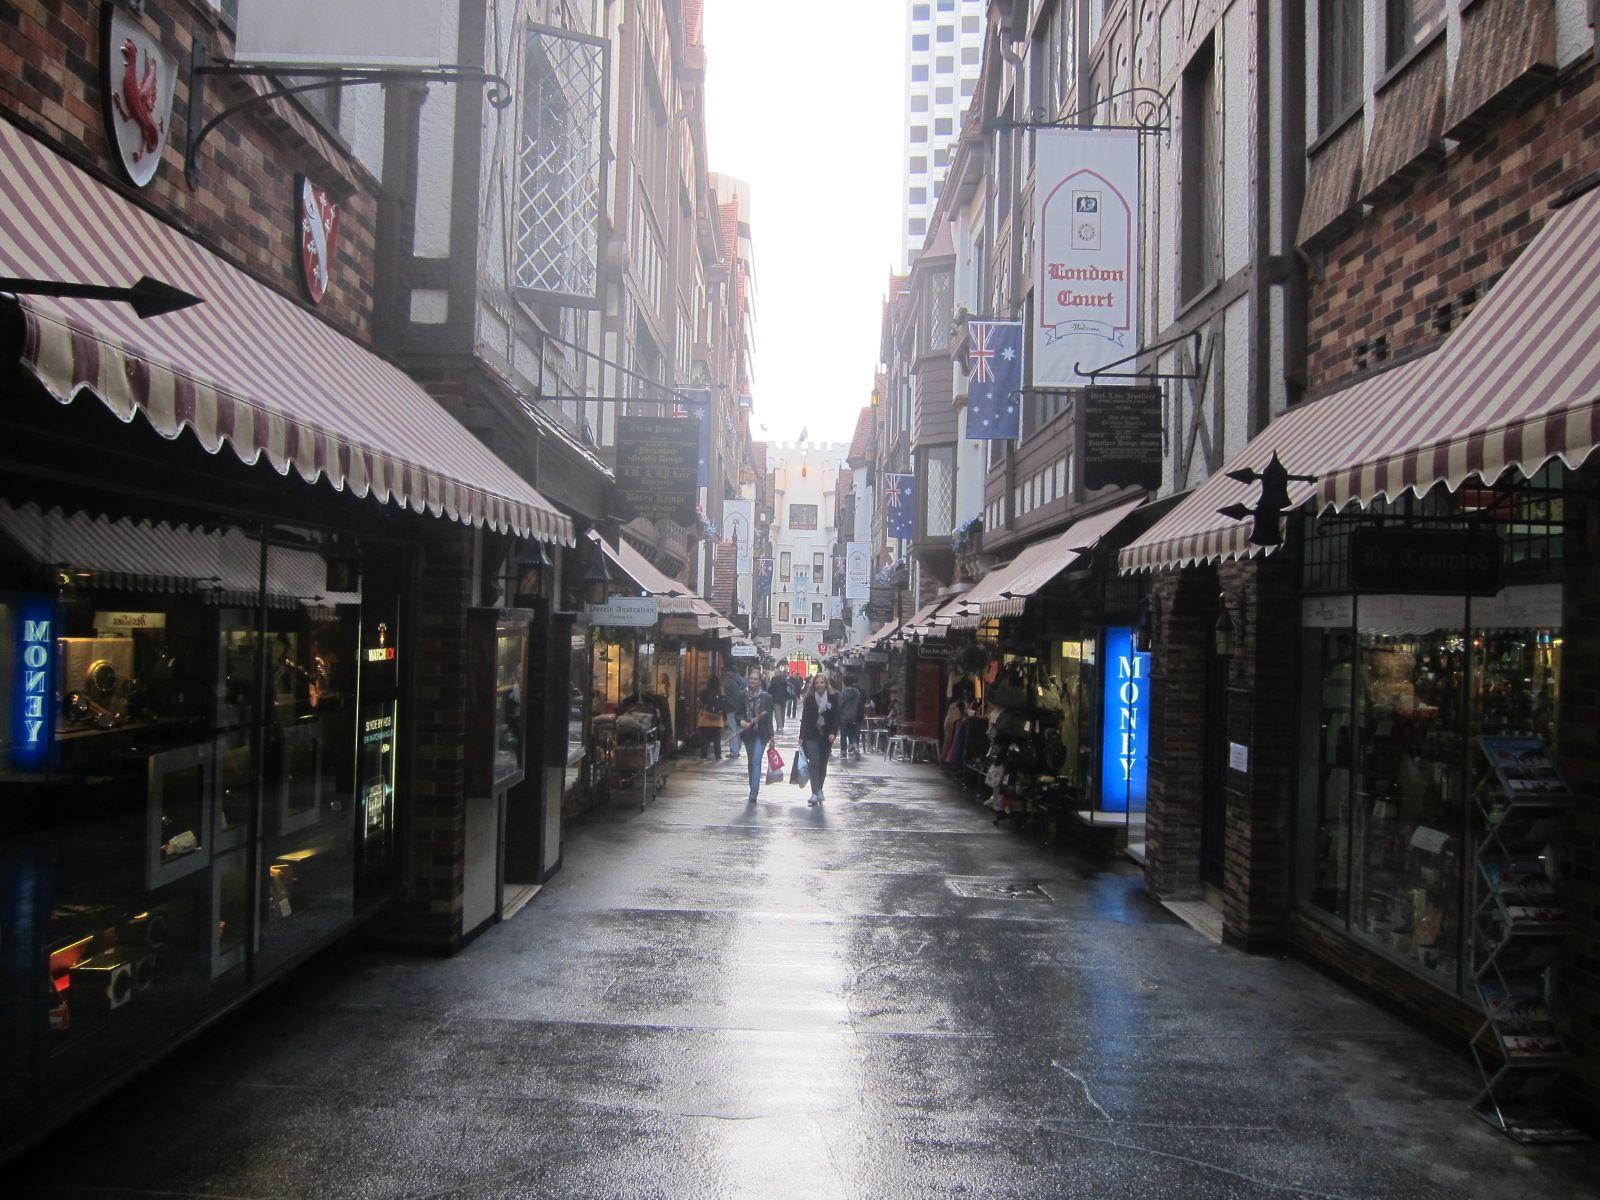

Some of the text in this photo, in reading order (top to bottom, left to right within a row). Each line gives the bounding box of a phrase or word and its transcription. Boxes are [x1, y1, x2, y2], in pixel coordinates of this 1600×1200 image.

[1048, 263, 1125, 282] London
[1057, 290, 1115, 308] Court
[1071, 322, 1100, 331] Welcome
[1359, 544, 1490, 574] Be Tempted
[616, 605, 654, 613] Australian
[1118, 656, 1143, 781] MONEY
